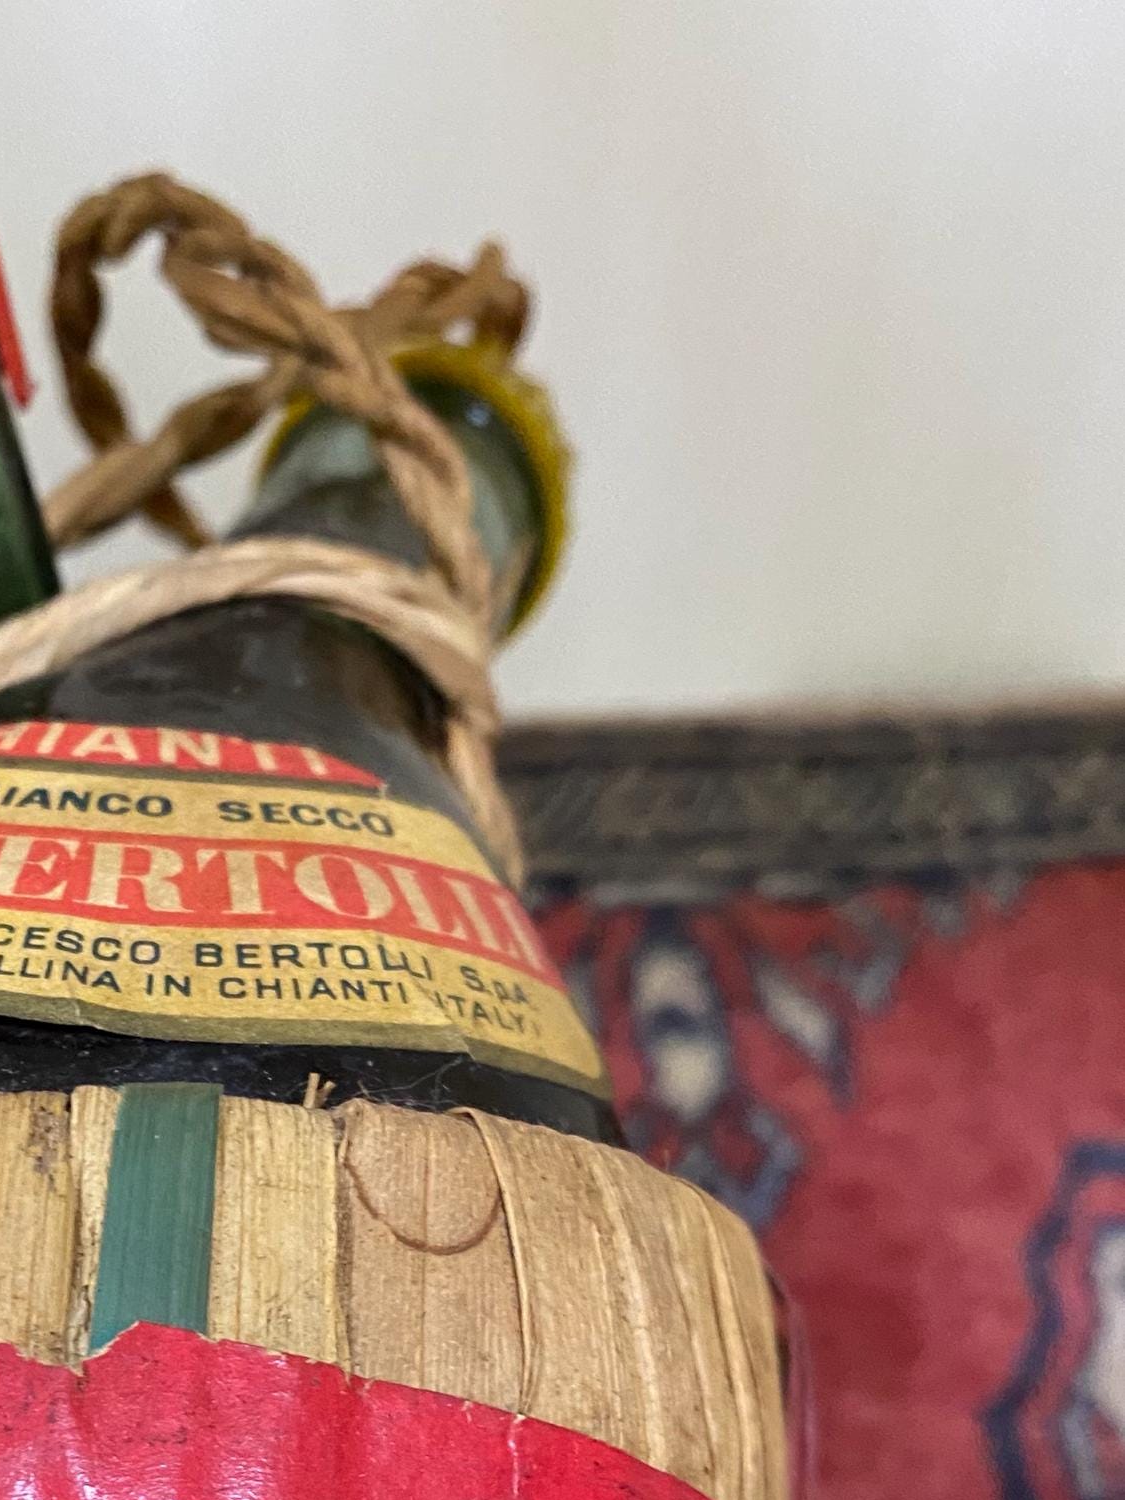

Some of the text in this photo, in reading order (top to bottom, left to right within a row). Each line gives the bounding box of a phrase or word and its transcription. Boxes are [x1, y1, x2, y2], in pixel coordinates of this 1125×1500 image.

[218, 800, 395, 837] SECCO
[195, 938, 433, 982] BERTOLLI
[145, 973, 192, 997] IN
[218, 976, 409, 1004] CHIANTI
